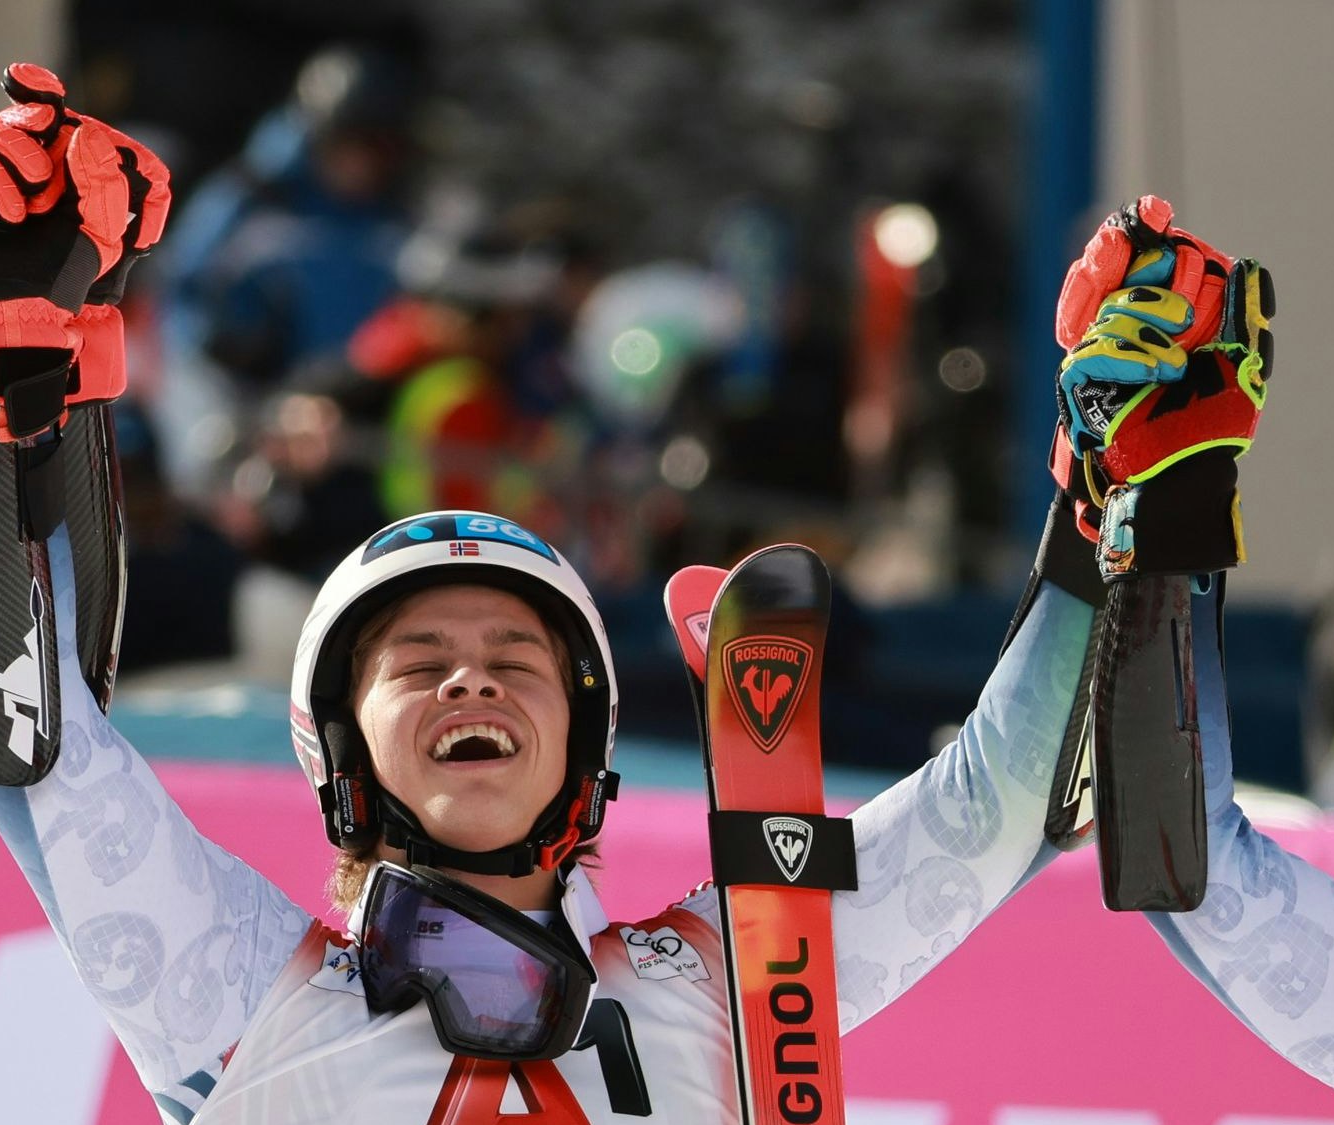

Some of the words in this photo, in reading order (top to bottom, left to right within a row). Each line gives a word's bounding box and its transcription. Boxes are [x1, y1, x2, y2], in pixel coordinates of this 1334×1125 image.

[467, 518, 536, 545] 5G
[734, 648, 801, 666] ROSSIGNOL
[768, 822, 807, 837] ROSSIGNOL
[637, 953, 657, 964] Audi
[638, 961, 652, 970] FIS
